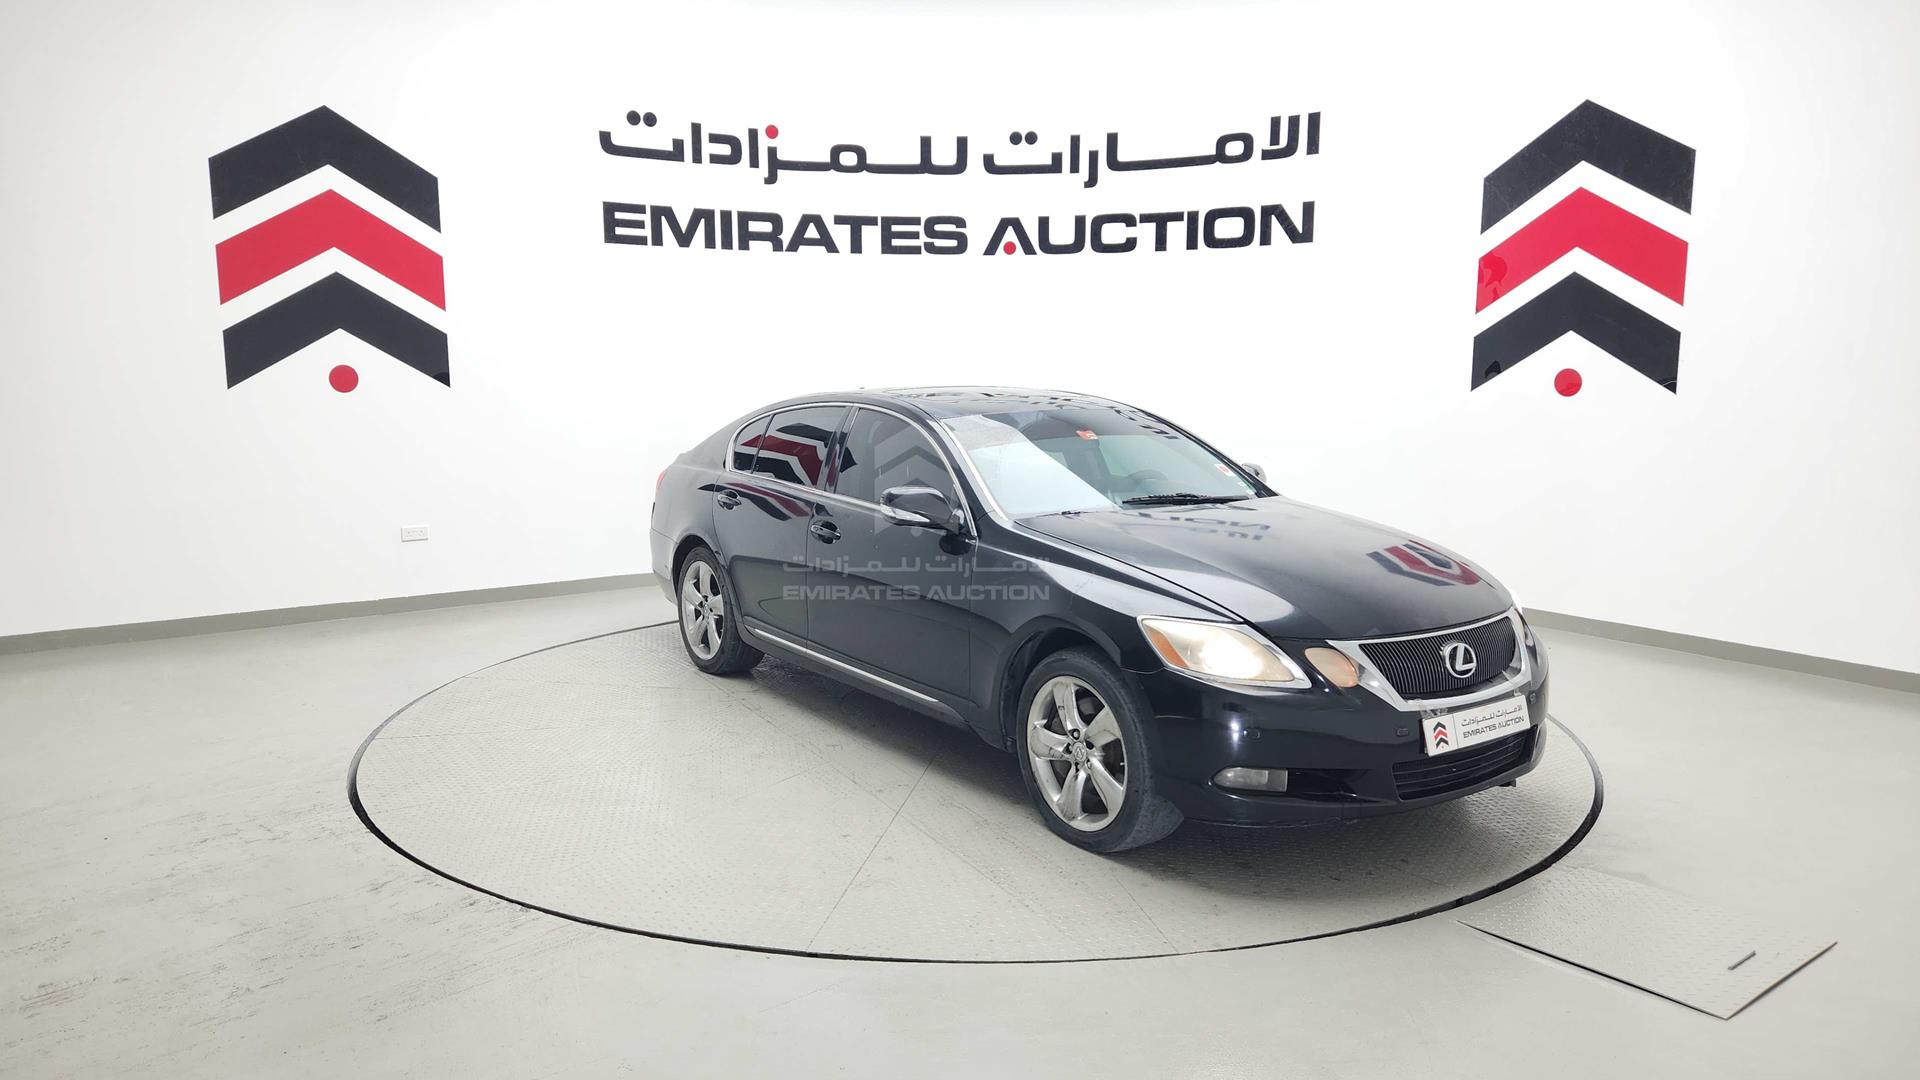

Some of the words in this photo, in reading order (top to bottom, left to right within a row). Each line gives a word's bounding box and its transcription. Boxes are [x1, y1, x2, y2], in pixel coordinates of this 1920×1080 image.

[599, 110, 968, 185] للمزادات
[983, 111, 1321, 189] الامارات
[603, 201, 968, 255] EMIRATES
[983, 201, 1315, 255] AUCTION
[1463, 723, 1498, 739] EMIRATES
[1498, 715, 1525, 729] AUCTION
